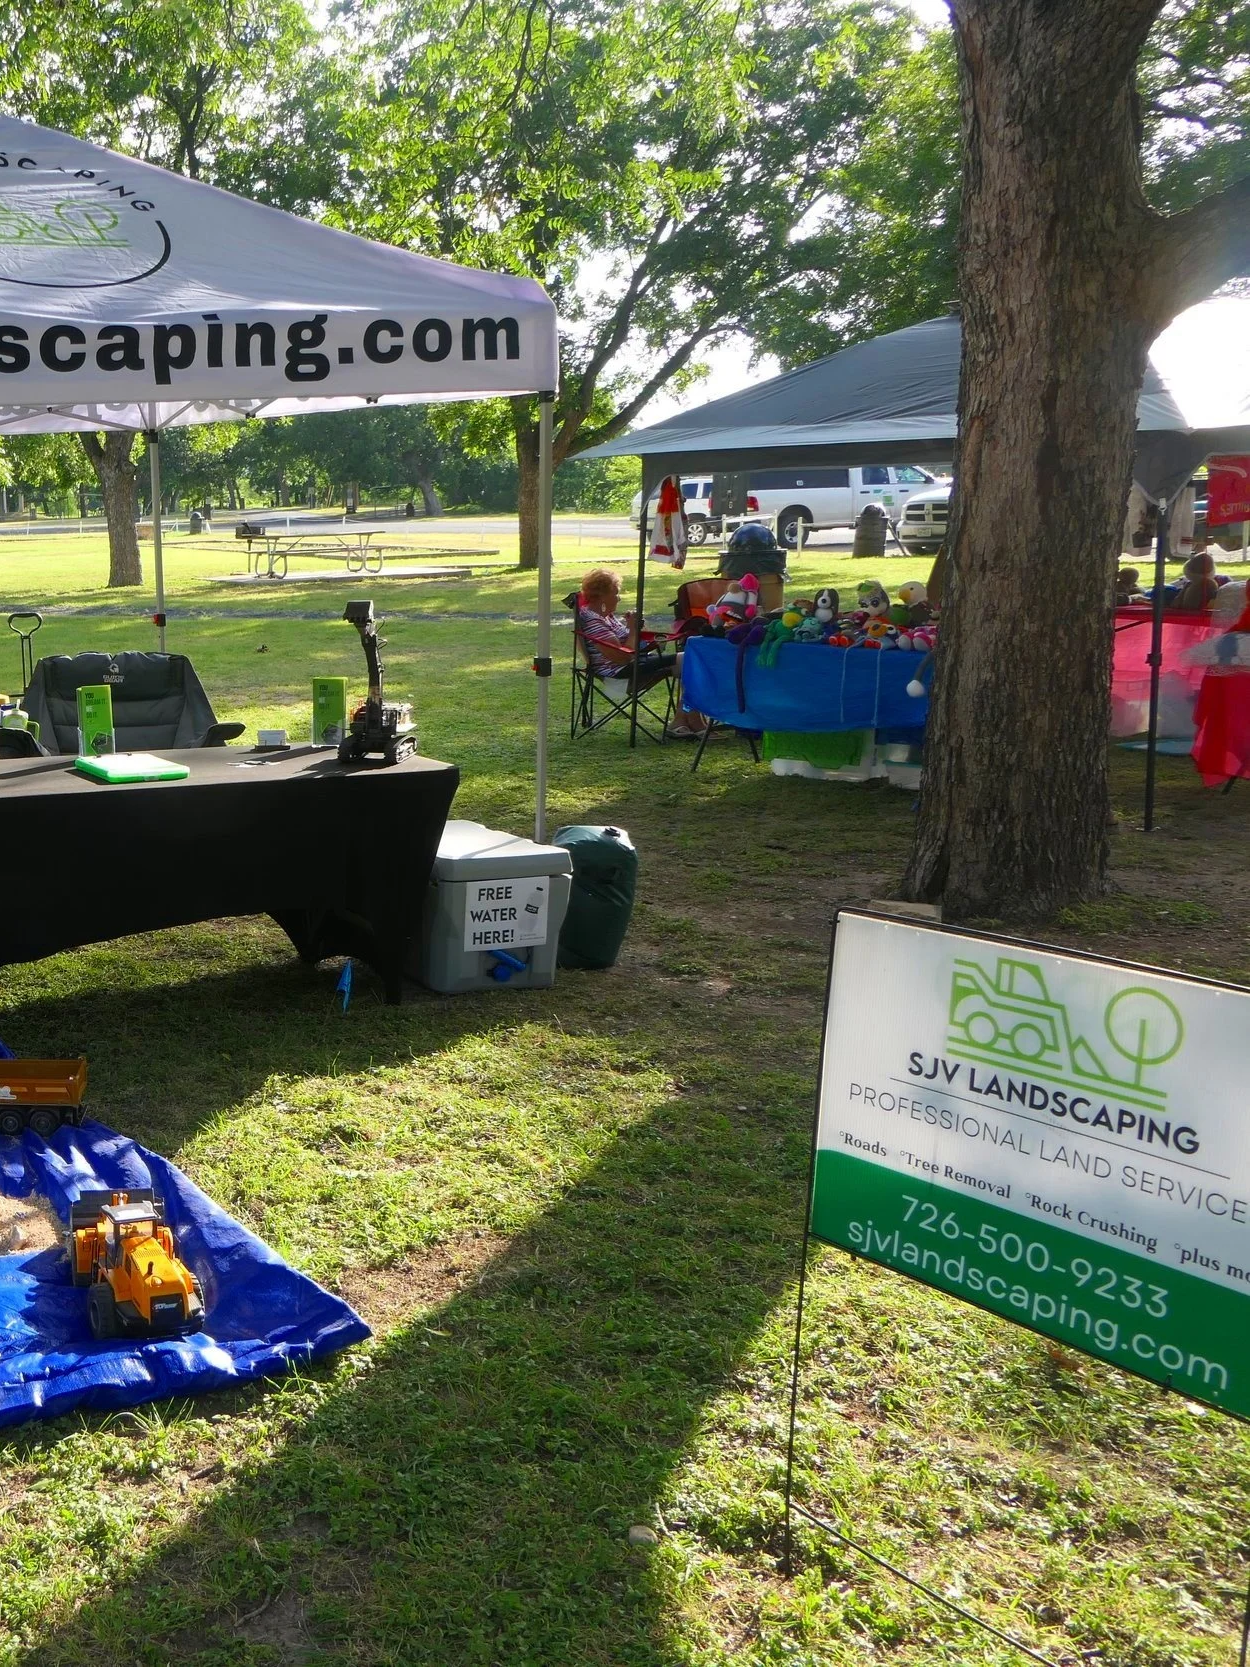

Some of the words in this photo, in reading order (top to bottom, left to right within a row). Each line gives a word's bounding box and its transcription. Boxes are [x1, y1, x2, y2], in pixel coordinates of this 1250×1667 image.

[470, 907, 517, 923] WATER
[472, 929, 514, 945] HERE!
[478, 886, 513, 901] FREE
[850, 1082, 1030, 1156] PROFESSIONAL
[1039, 1138, 1112, 1179] LAND
[907, 1052, 962, 1084] SJV
[968, 1068, 1201, 1155] LANDSCAPING
[943, 1164, 1012, 1200] Removal
[1077, 1209, 1158, 1254] Crushing
[901, 1194, 1169, 1318] 726-500-9233
[847, 1219, 1230, 1390] sjvlandscaping.com
